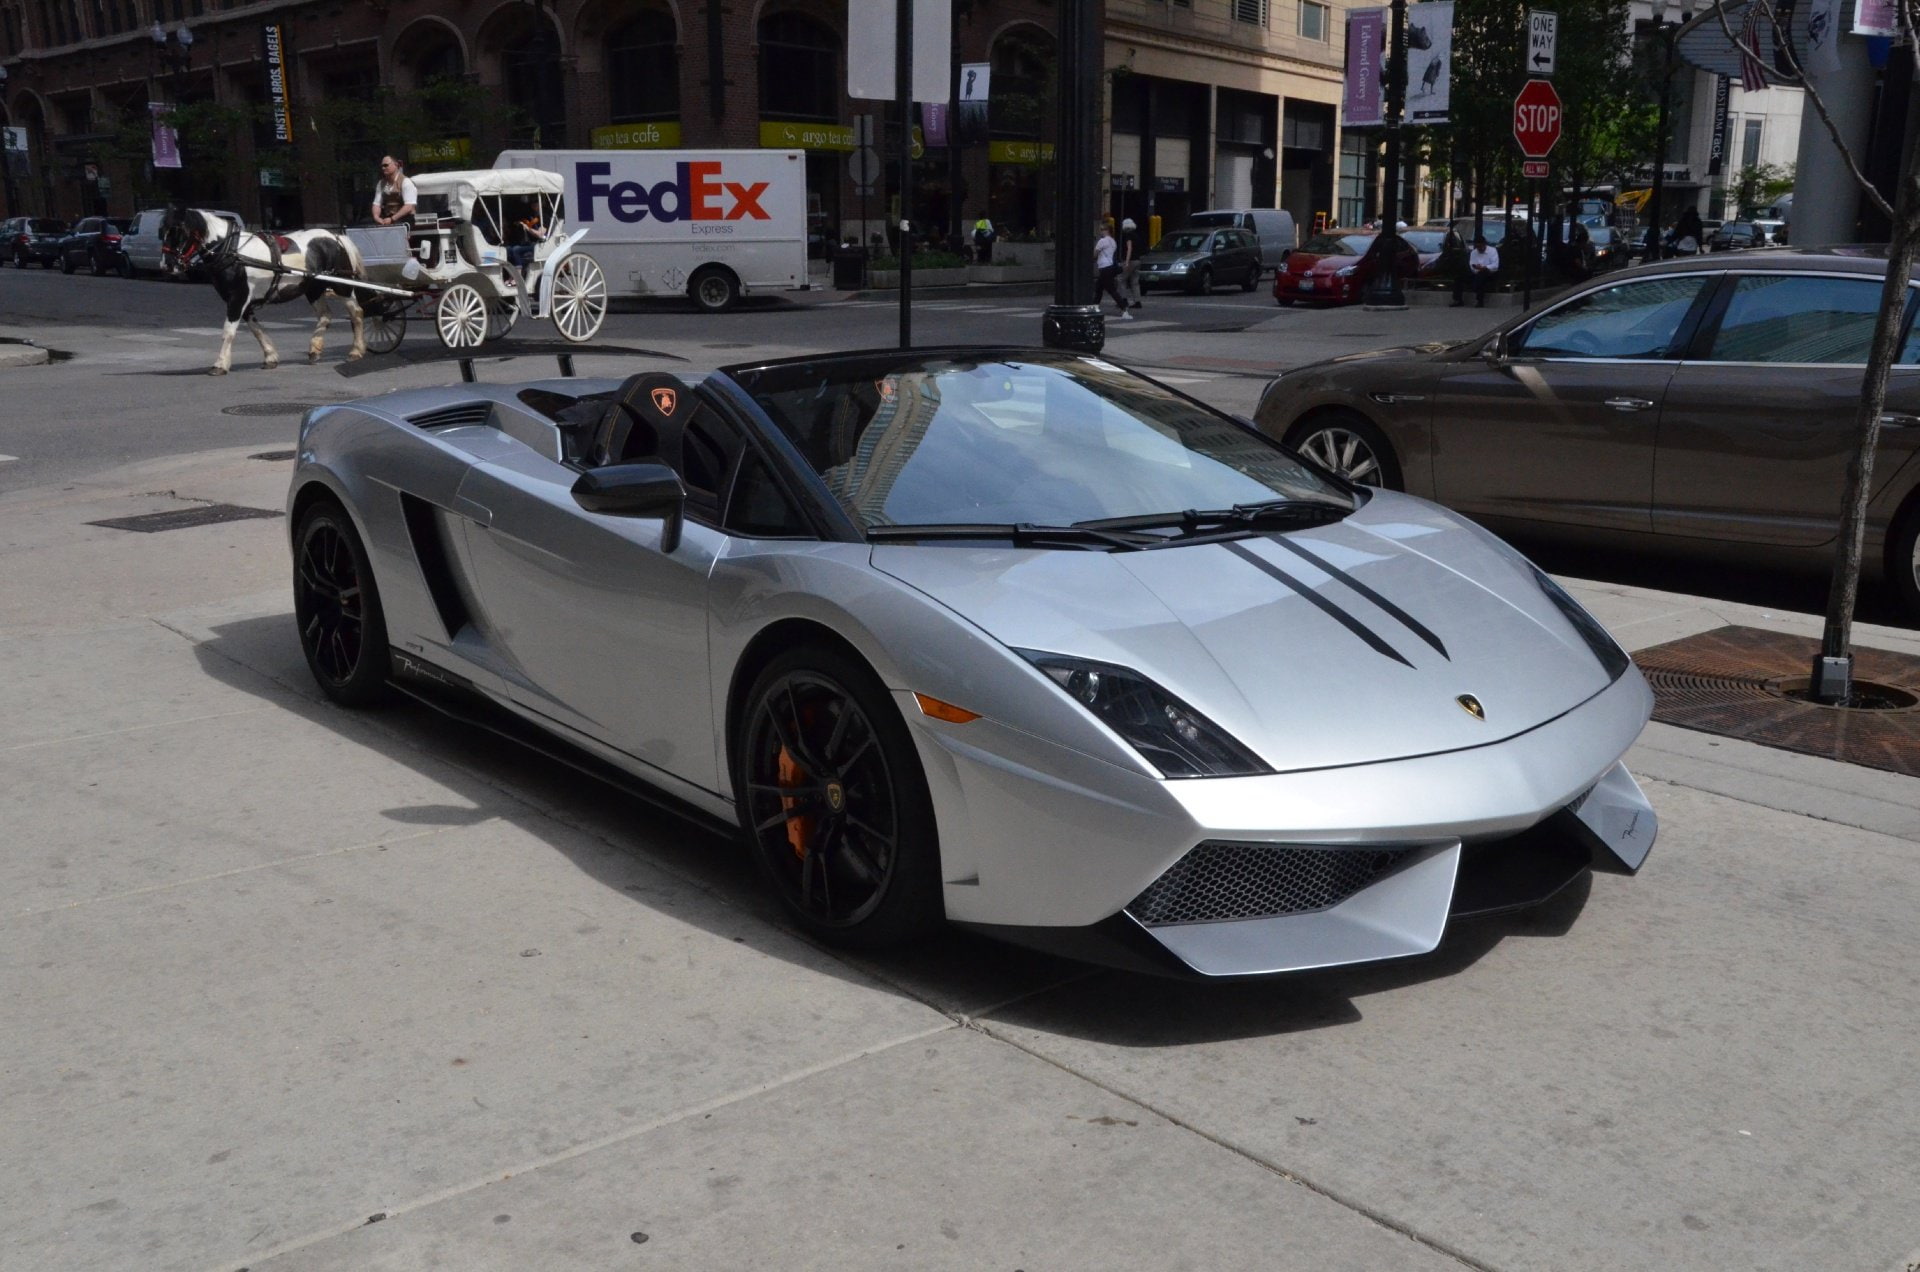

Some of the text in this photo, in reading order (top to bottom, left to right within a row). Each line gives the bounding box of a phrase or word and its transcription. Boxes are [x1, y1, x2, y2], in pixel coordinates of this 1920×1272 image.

[1533, 17, 1553, 33] ONE
[1360, 25, 1372, 65] Edward
[1532, 34, 1553, 49] WAY
[265, 26, 288, 140] EINSTEN BROS. BAGELS
[1356, 69, 1369, 99] Gorey
[1517, 104, 1559, 133] STOP
[632, 123, 660, 143] café
[803, 131, 827, 148] argo
[829, 131, 841, 145] tea
[1711, 133, 1722, 160] rack
[1525, 164, 1547, 174] ALL WAY
[576, 162, 771, 223] FedEx
[691, 223, 734, 235] Express
